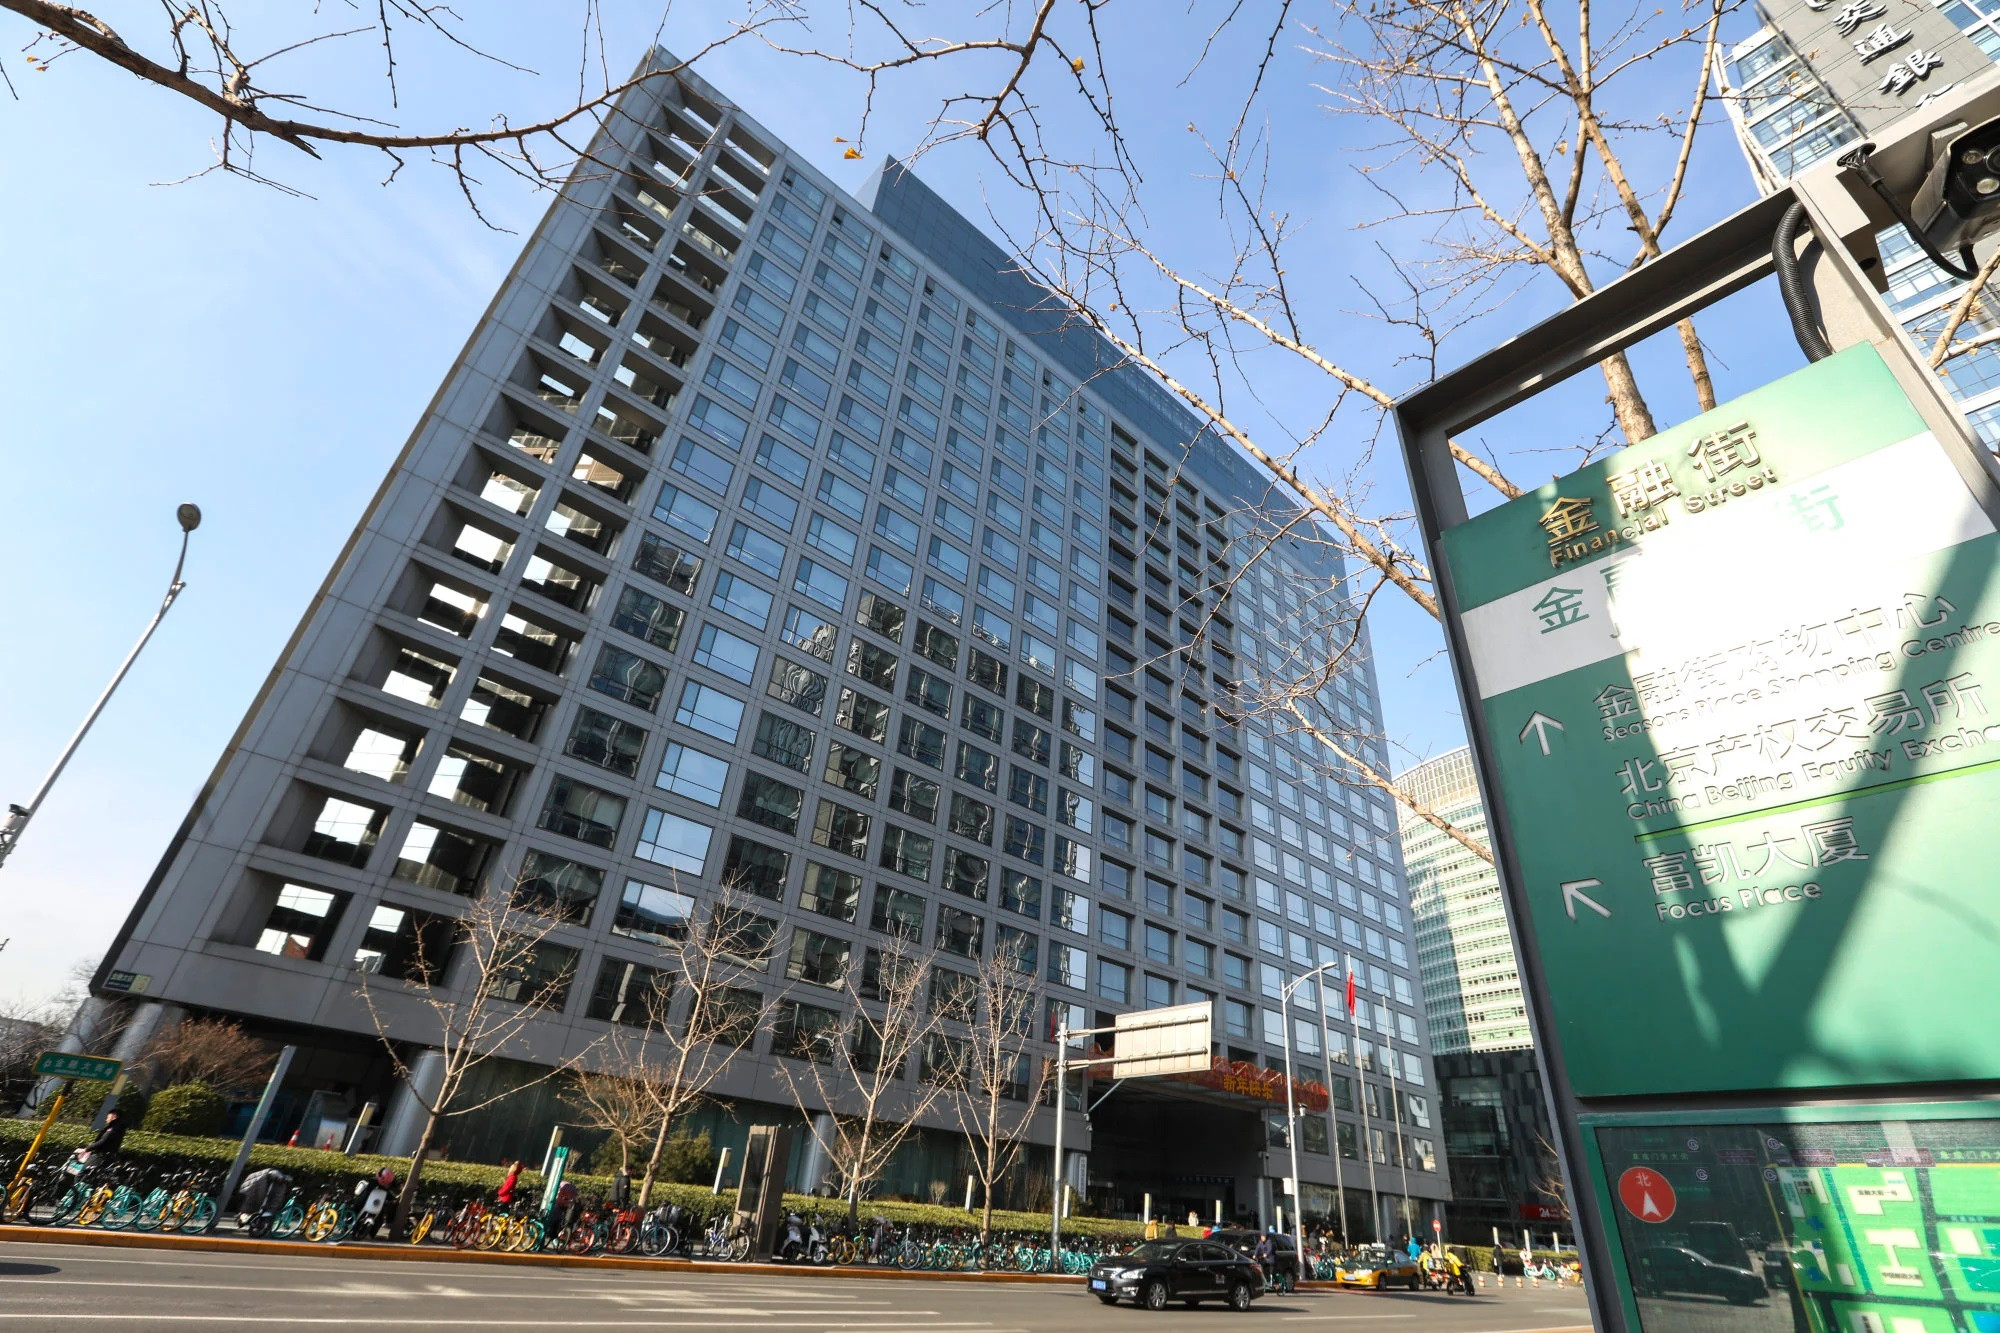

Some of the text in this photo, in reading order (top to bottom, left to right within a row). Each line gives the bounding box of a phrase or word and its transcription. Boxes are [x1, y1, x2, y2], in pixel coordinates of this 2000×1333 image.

[1539, 420, 1761, 548] 金融街
[1549, 465, 1778, 569] Financial Street
[1602, 707, 1690, 743] Seasons
[1900, 621, 2000, 659] Centre
[1615, 671, 1989, 796] 北京产权交易所
[1626, 793, 1701, 821] China
[1704, 771, 1798, 806] Beijing
[1801, 747, 1893, 783] Equity
[1641, 815, 1870, 896] 富凯大厦
[1655, 881, 1822, 922] Focus Place
[1223, 1073, 1273, 1100] 新年快乐
[1635, 1172, 1651, 1187] 北
